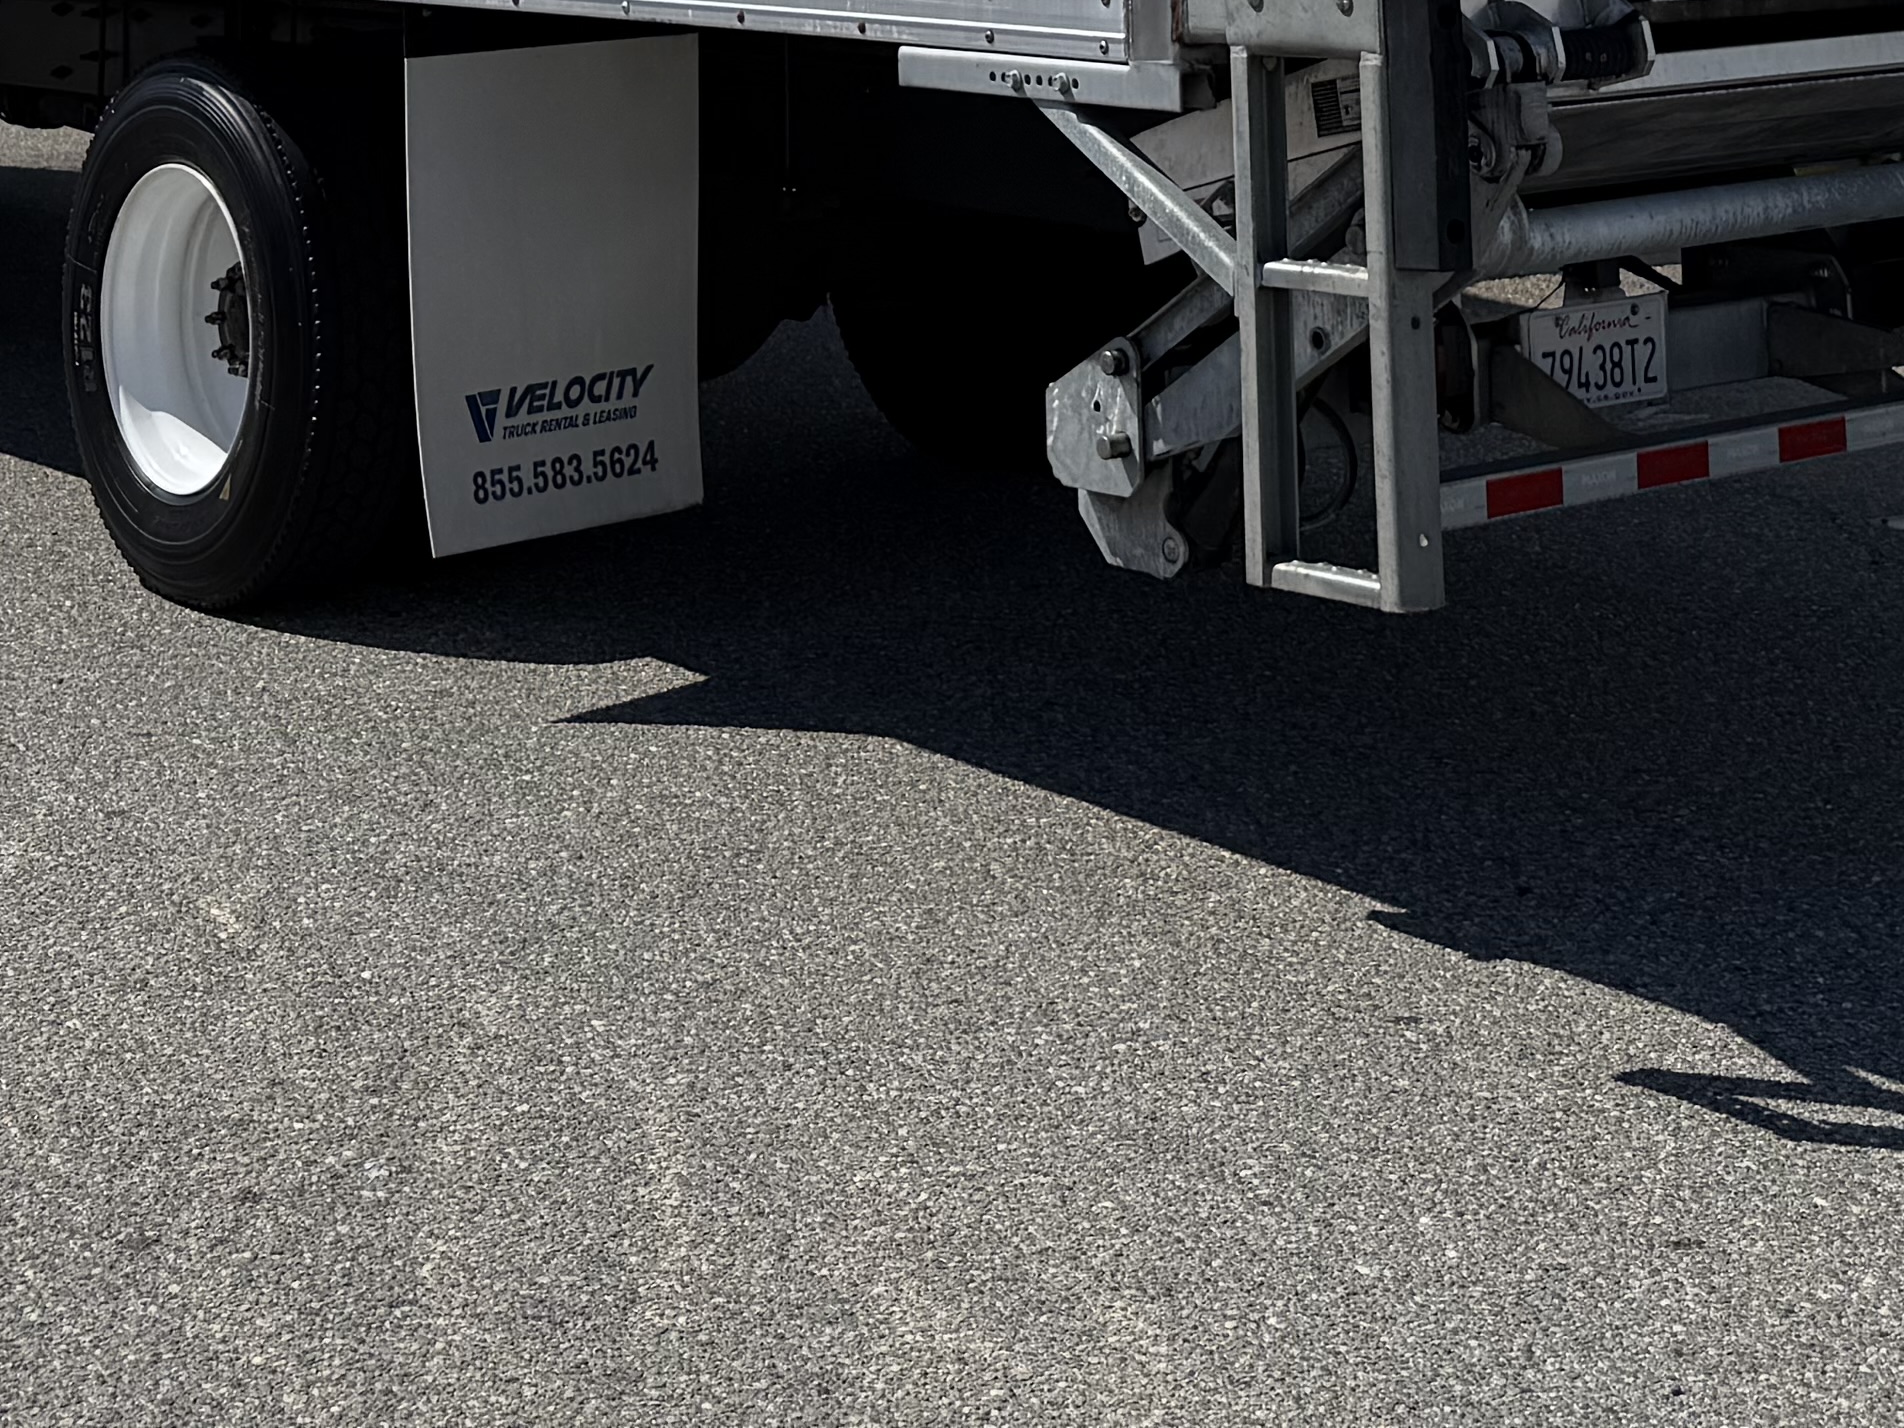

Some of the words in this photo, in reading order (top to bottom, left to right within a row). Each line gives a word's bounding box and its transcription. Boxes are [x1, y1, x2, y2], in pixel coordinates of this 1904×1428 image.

[1558, 313, 1640, 341] California
[504, 364, 655, 419] VELOCITY
[1542, 336, 1658, 393] 79438T2
[502, 420, 539, 440] TRUCK
[539, 413, 580, 434] RENTAL
[581, 411, 591, 427] &
[593, 405, 638, 425] LEASING
[472, 439, 659, 505] 855.583.5624
